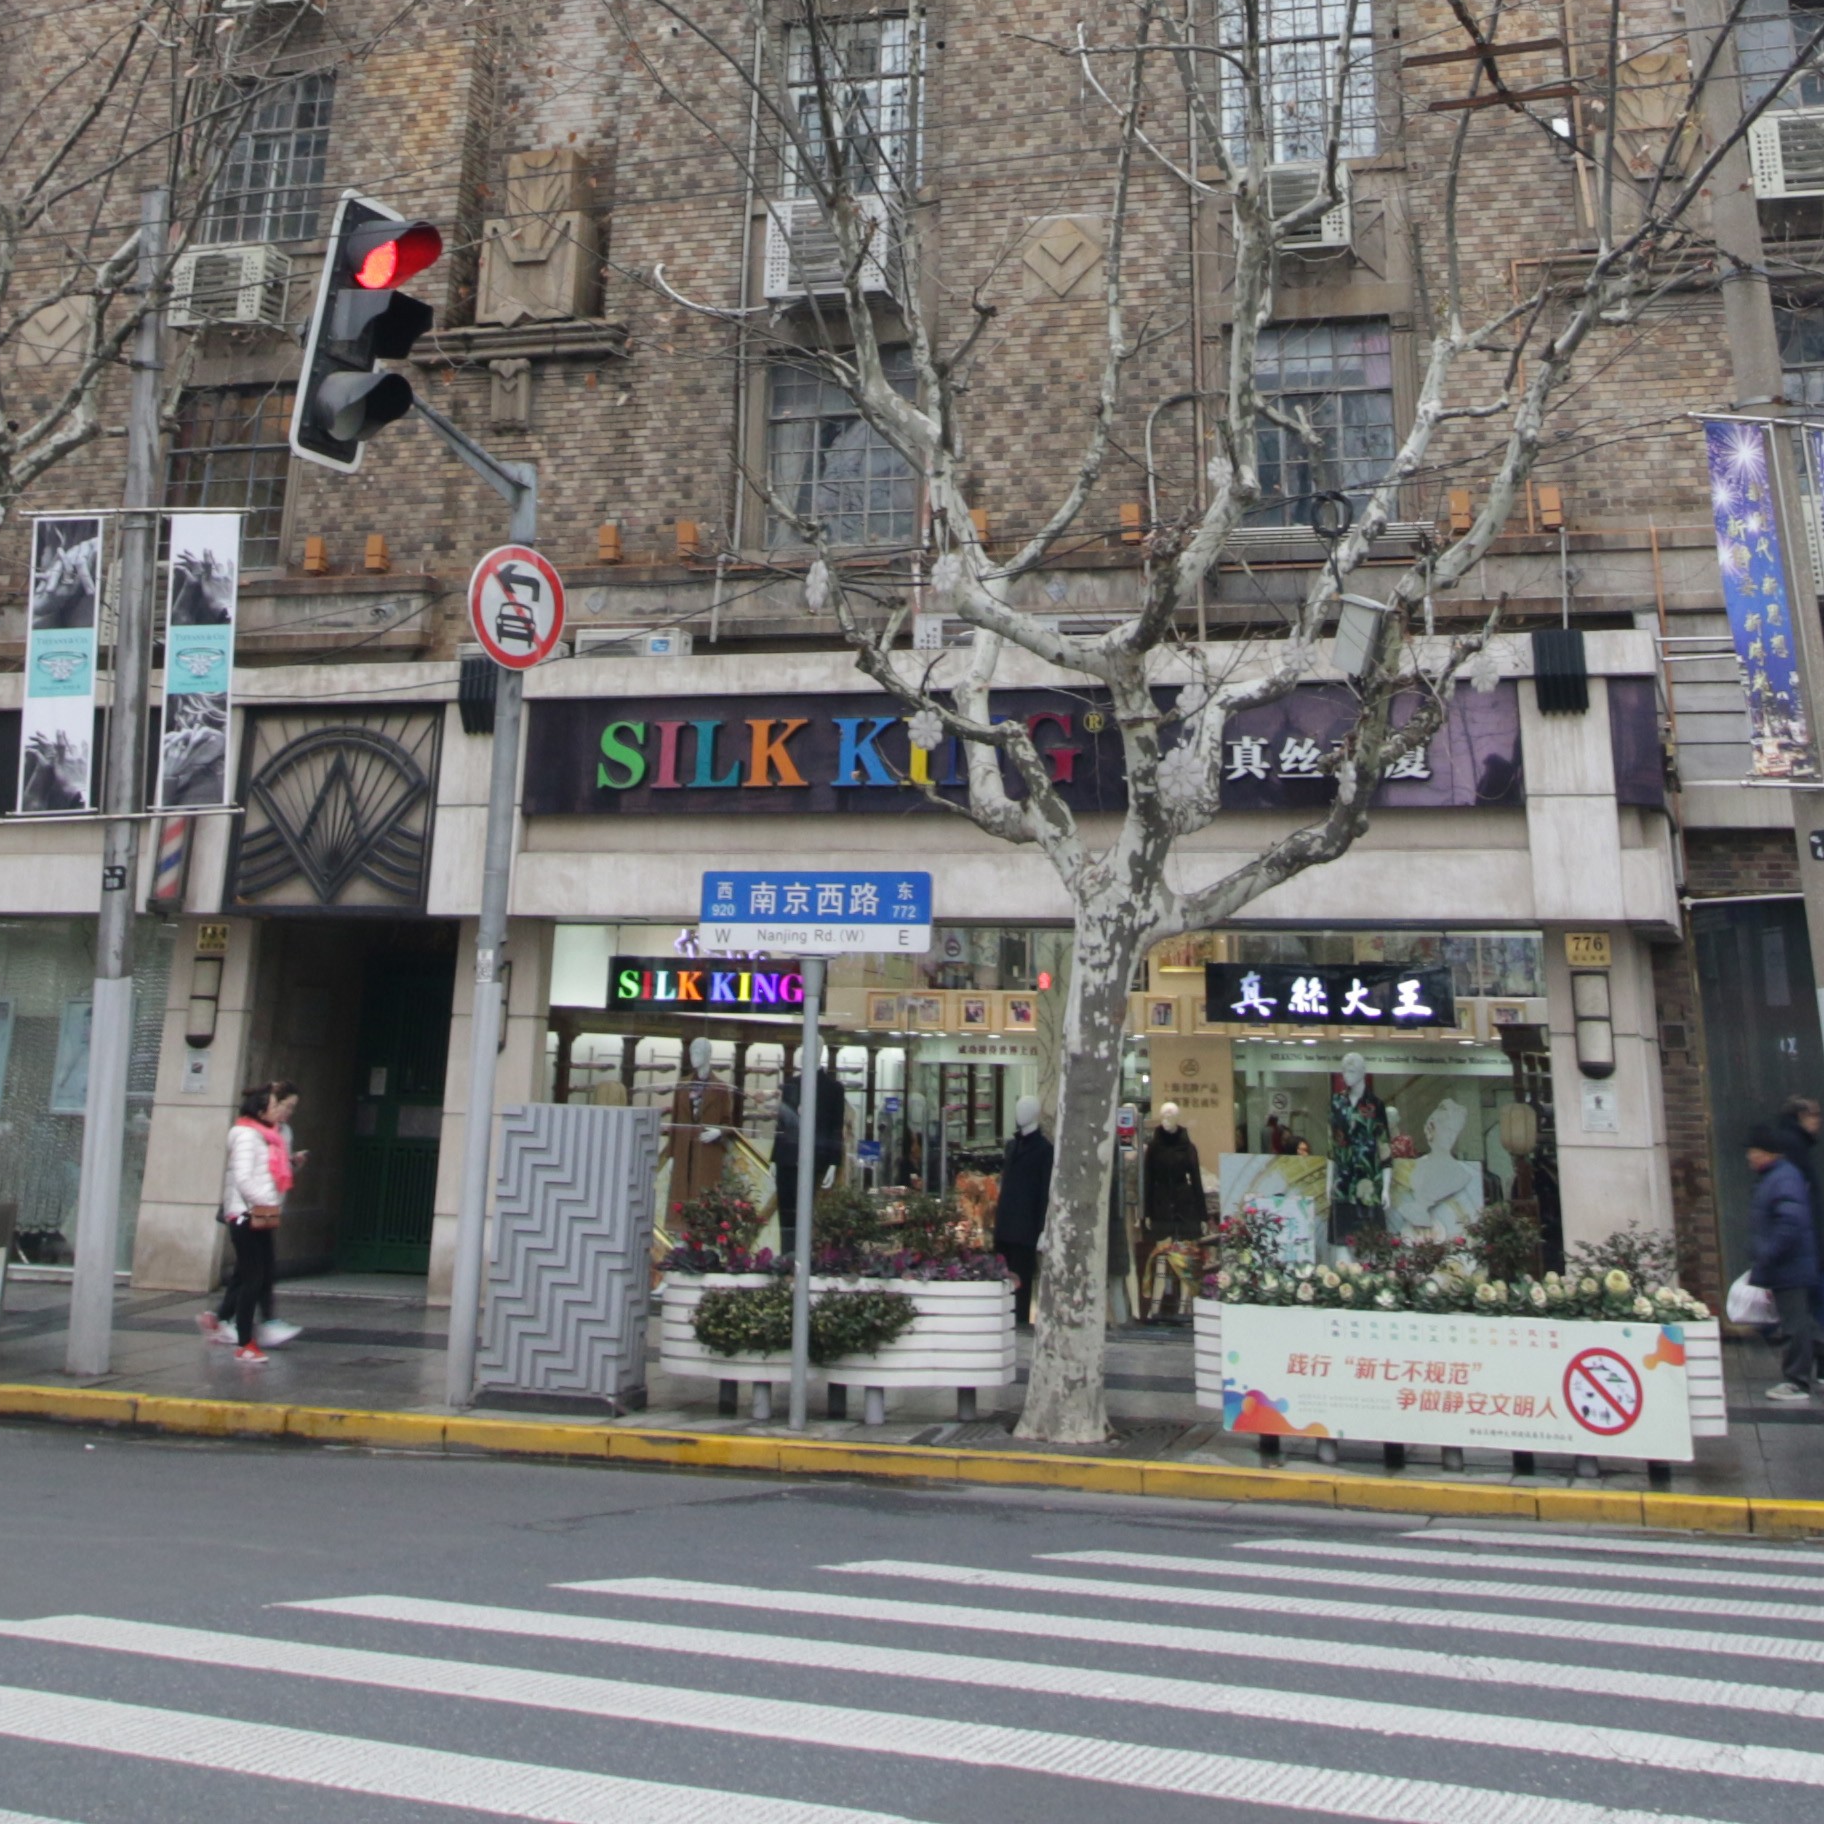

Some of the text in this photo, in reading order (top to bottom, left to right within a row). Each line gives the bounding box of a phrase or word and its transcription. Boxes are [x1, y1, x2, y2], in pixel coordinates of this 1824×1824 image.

[597, 718, 808, 789] SILK
[711, 904, 916, 919] 920 772
[717, 881, 914, 916] 西 南京西路 东
[715, 929, 731, 942] W
[758, 930, 807, 944] Nanjing
[898, 930, 909, 945] E
[1572, 936, 1603, 951] 776
[618, 970, 804, 1003] SILK KING
[1396, 1387, 1559, 1420] 争做静安文明人
